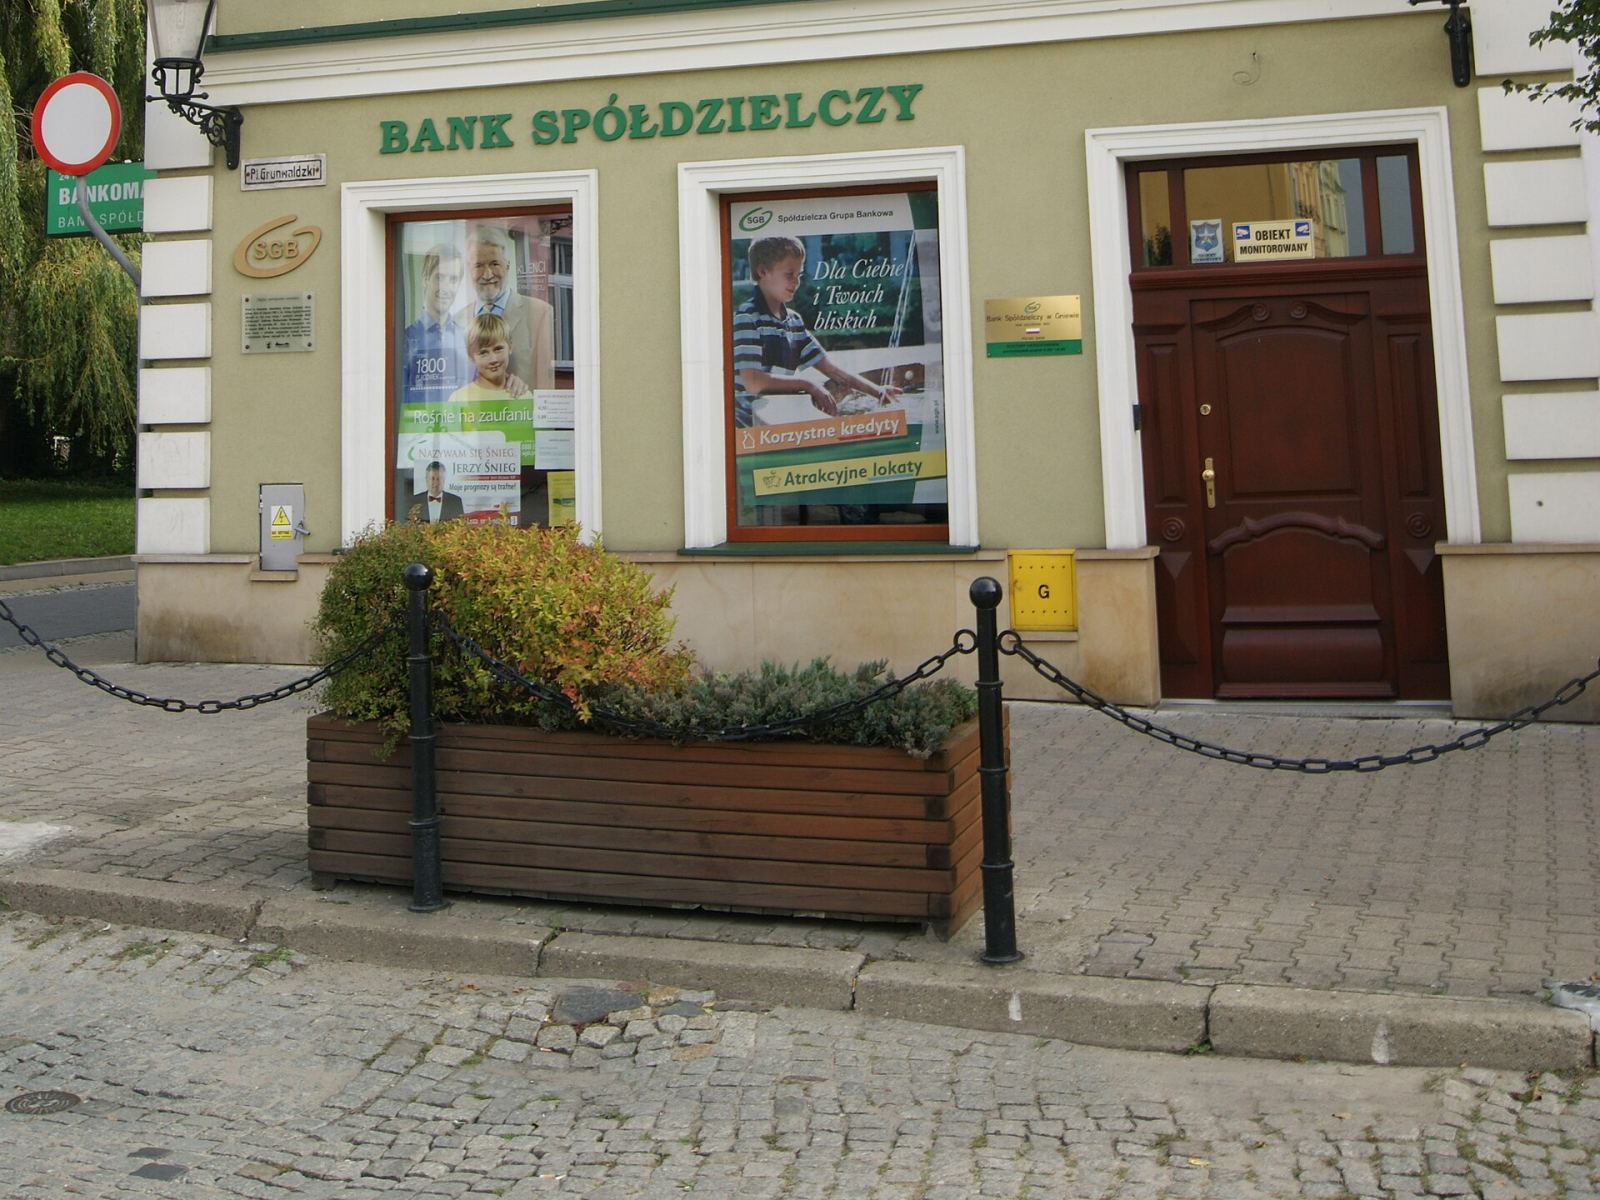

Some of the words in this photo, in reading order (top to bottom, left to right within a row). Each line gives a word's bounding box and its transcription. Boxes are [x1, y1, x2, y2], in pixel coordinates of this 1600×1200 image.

[379, 113, 515, 154] BANK
[531, 83, 924, 146] SPÓŁDZIELCZY
[58, 216, 86, 228] BAN
[747, 215, 765, 224] SGB
[777, 213, 828, 223] Spółdzielcza
[829, 211, 855, 220] Grupa
[856, 209, 894, 218] Bankowa
[1255, 229, 1291, 241] OBIEKT
[254, 239, 299, 260] SGB
[1240, 243, 1308, 255] MONITOROWANY
[813, 259, 847, 280] Dla
[852, 257, 905, 278] Ciebie
[813, 286, 821, 306] i
[826, 283, 885, 306] Twoich
[813, 309, 877, 330] bliskich
[415, 357, 447, 374] 1800
[413, 410, 456, 424] Rośnie
[458, 412, 475, 423] na
[479, 407, 534, 424] zaufaniu
[759, 426, 836, 445] Korzystne
[840, 417, 900, 437] kredyty
[452, 462, 482, 475] JERZY
[485, 459, 516, 473] ŚNIEG
[784, 467, 867, 486] Atrakcyjne
[873, 460, 922, 477] lokaty
[1038, 584, 1050, 599] G
